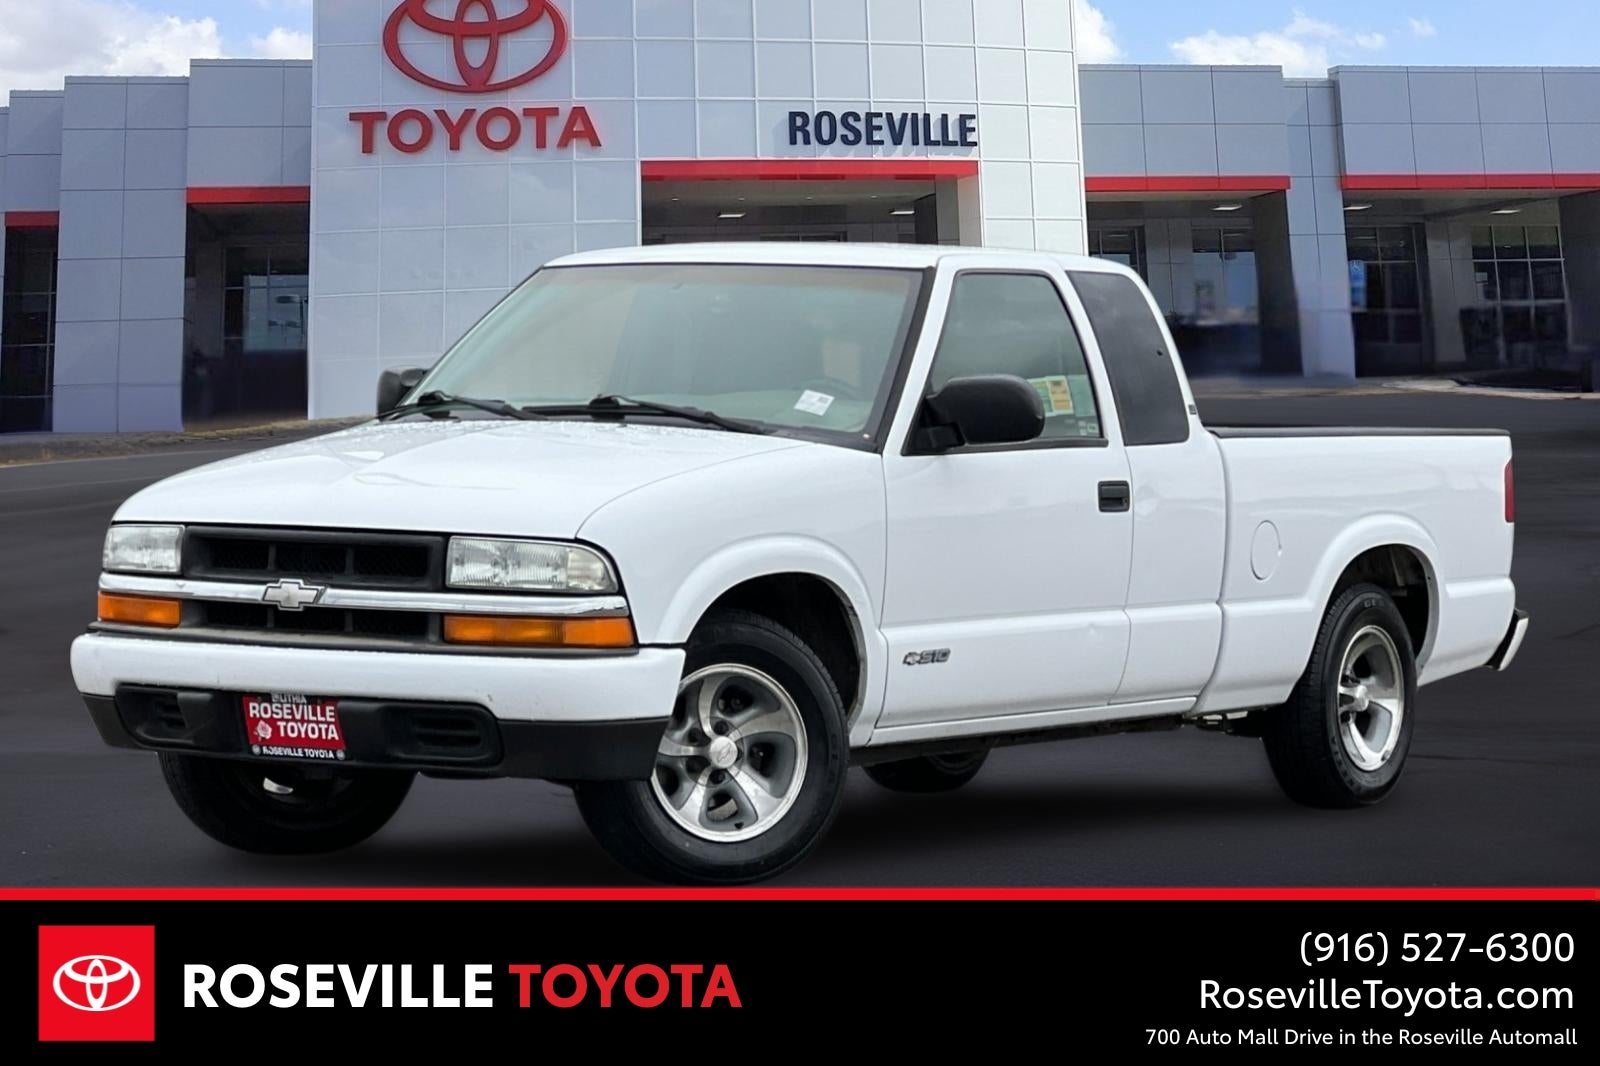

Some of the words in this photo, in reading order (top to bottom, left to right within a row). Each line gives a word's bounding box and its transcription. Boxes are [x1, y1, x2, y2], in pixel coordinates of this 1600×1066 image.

[349, 106, 602, 154] TOYOTA
[788, 110, 979, 147] ROSEVILLE
[249, 702, 335, 722] ROSEVILLE
[277, 721, 339, 741] TOYOTA
[262, 746, 304, 757] ROSEVILLE
[305, 748, 335, 759] TOYOTA
